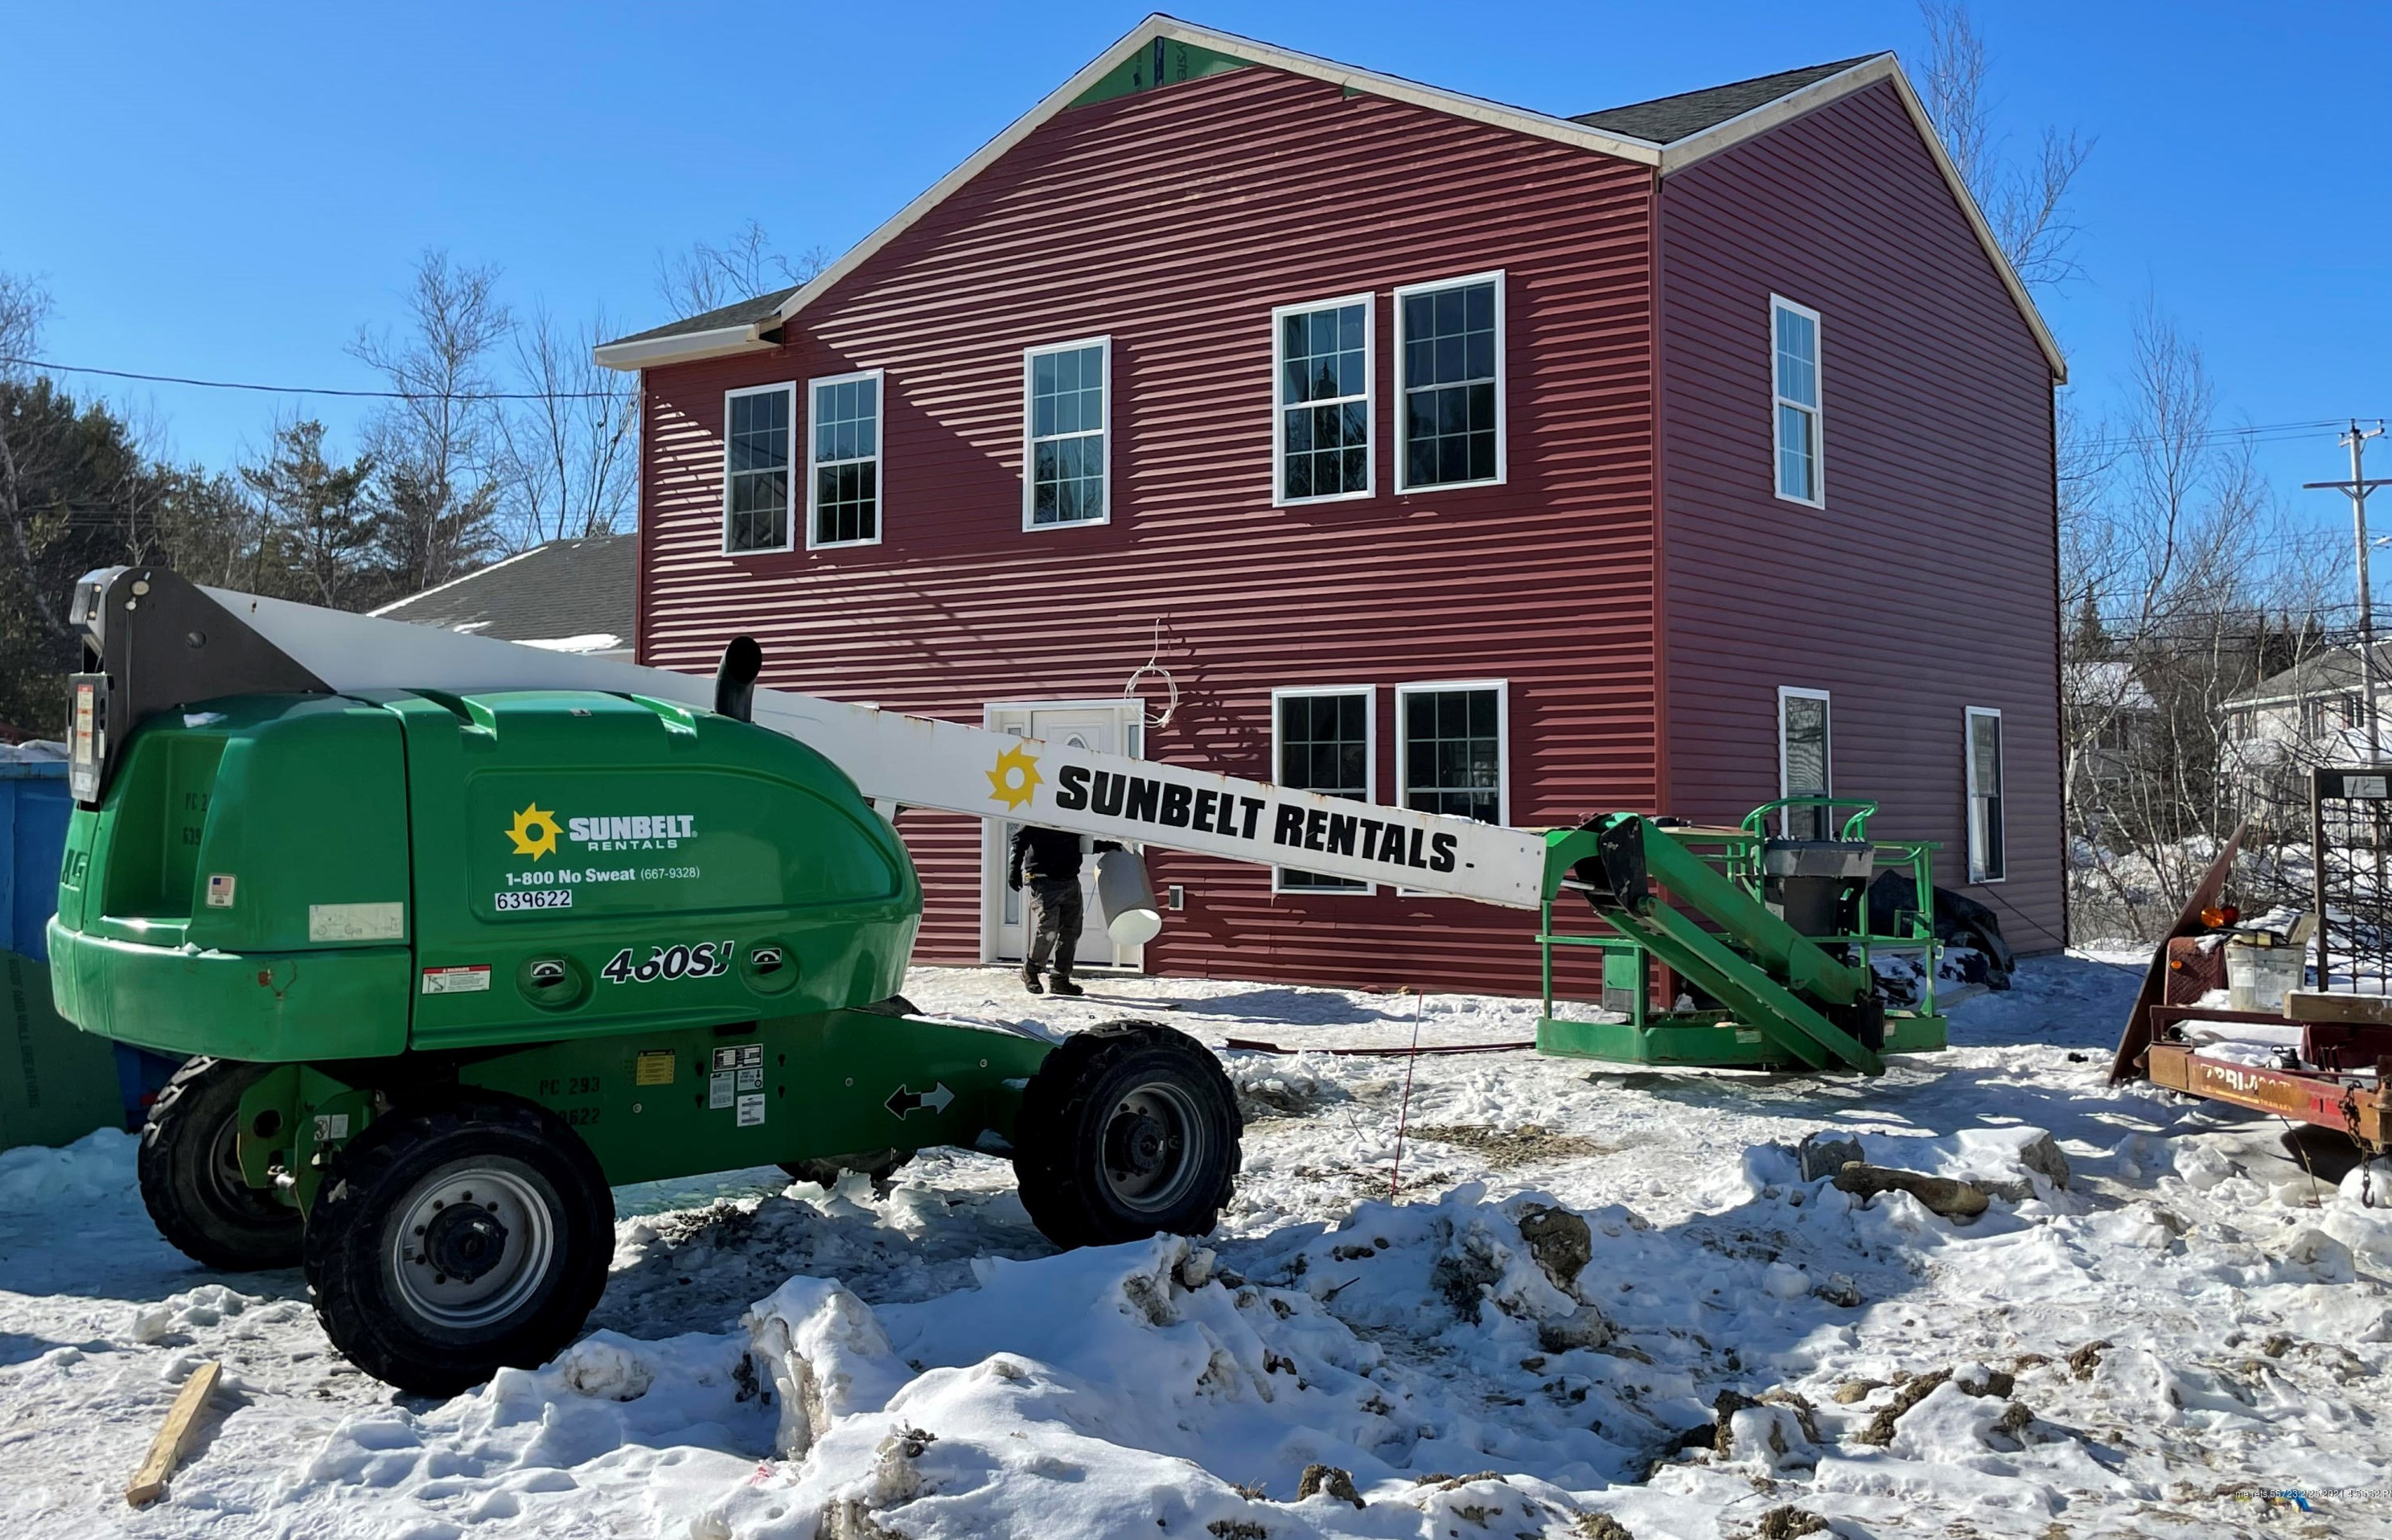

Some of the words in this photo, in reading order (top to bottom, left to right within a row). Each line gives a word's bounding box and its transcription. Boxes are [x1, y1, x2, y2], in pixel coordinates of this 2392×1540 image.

[1056, 765, 1264, 840] SUNBELT
[1273, 803, 1457, 873] RENTALS
[588, 840, 678, 852] RENTALS
[506, 871, 554, 886] 1-800
[558, 869, 582, 884] No
[586, 868, 636, 882] Sweat
[641, 866, 701, 881] (667-9328)
[497, 890, 570, 910] 639622
[540, 1078, 561, 1096] PC
[569, 1076, 601, 1095] 293
